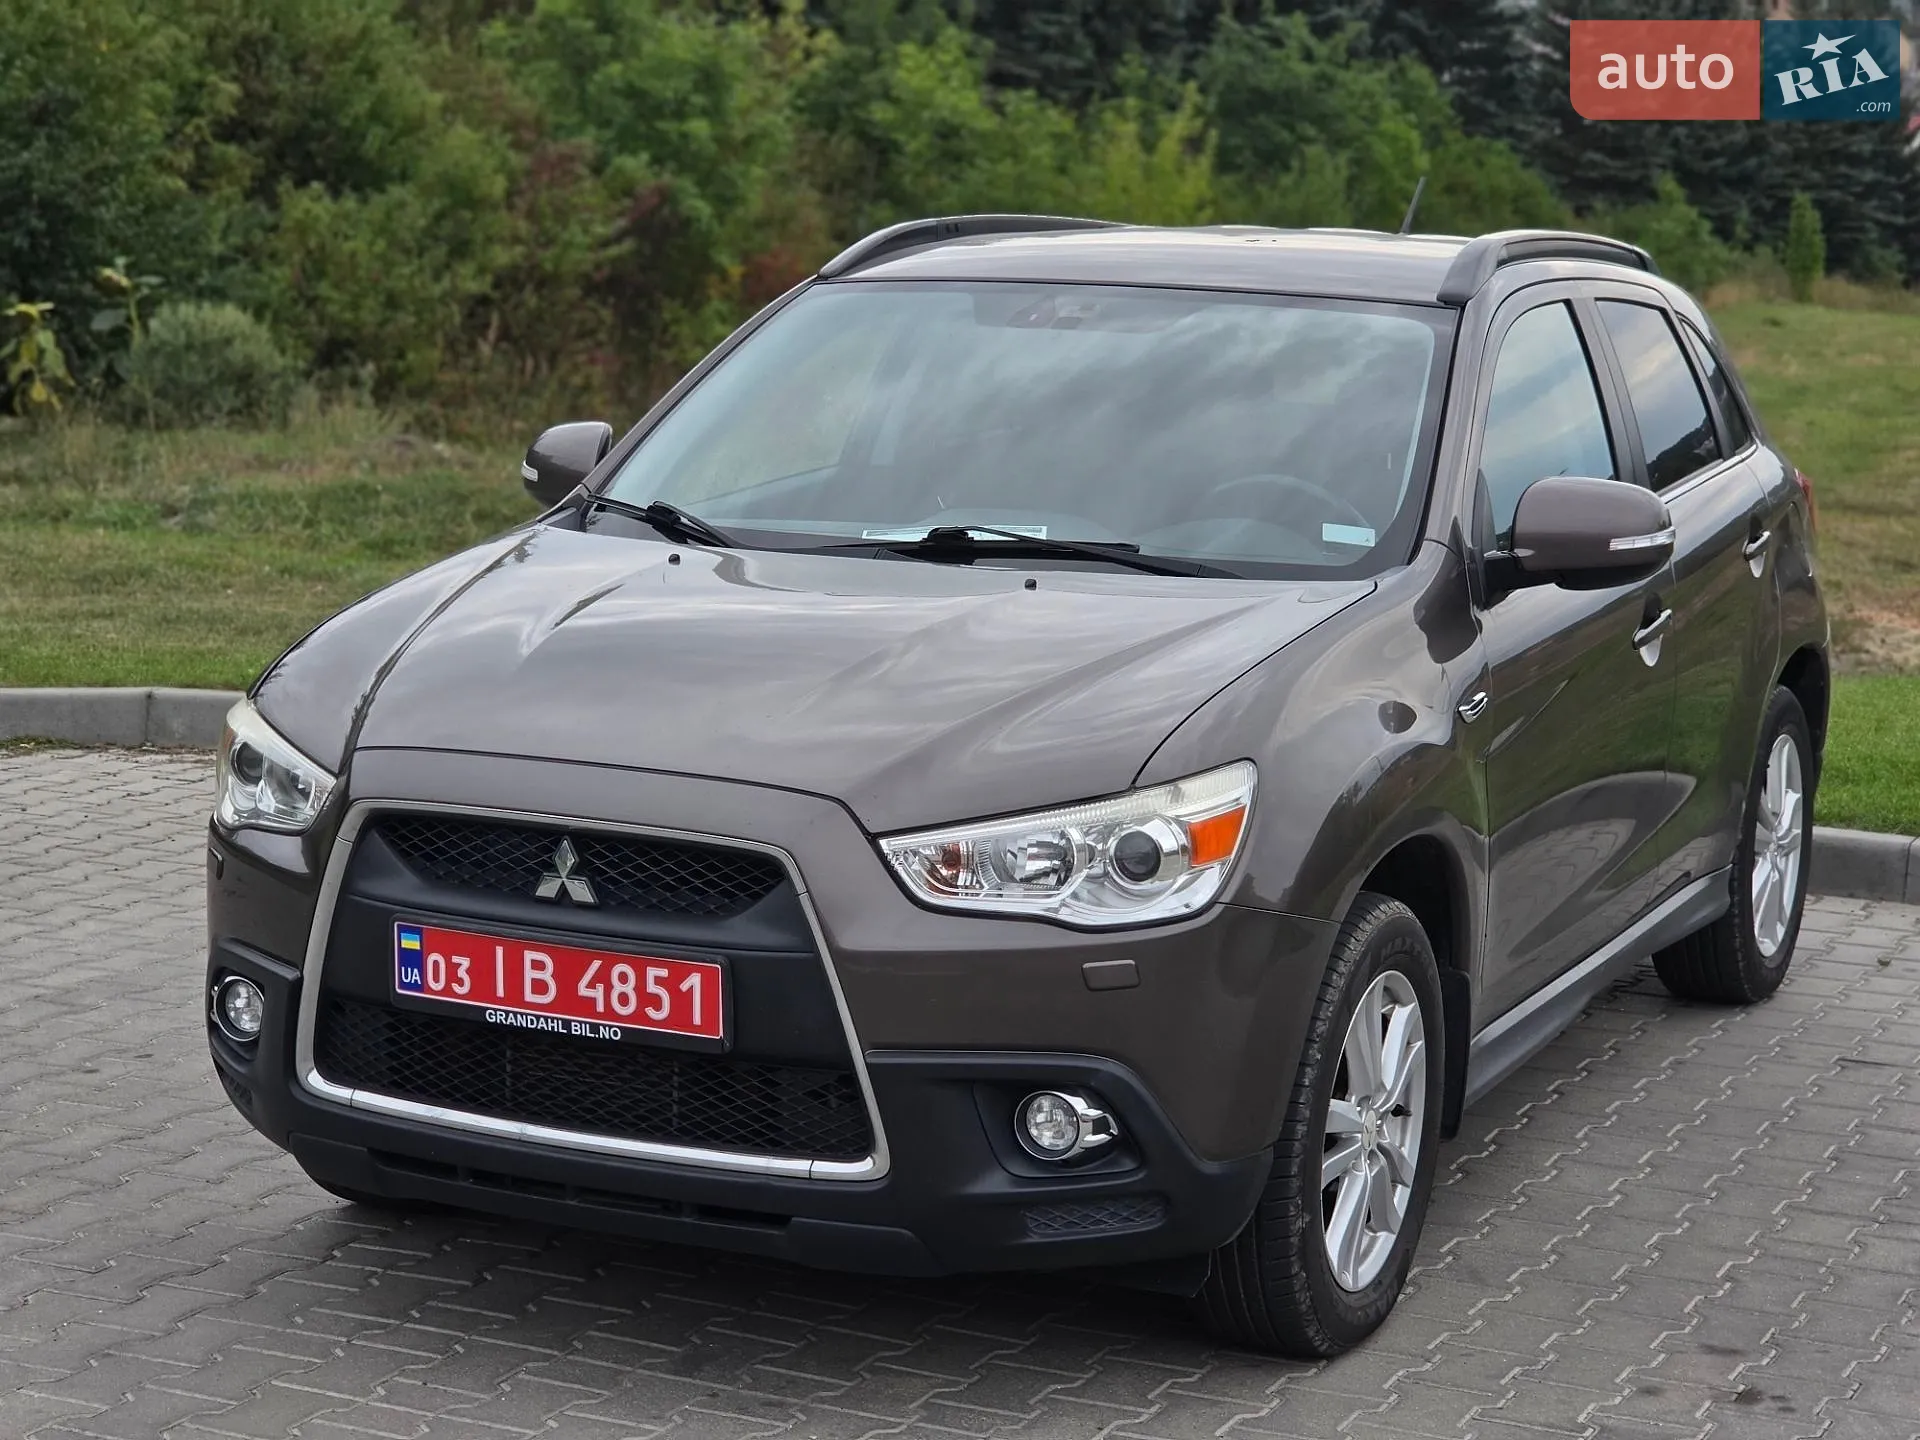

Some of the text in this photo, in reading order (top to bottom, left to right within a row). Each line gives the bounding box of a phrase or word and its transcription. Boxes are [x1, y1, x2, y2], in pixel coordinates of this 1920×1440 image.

[401, 967, 421, 985] UA
[426, 953, 472, 995] 03
[577, 959, 703, 1026] 4851
[486, 1009, 621, 1041] GRANDAHL BIL.NO
